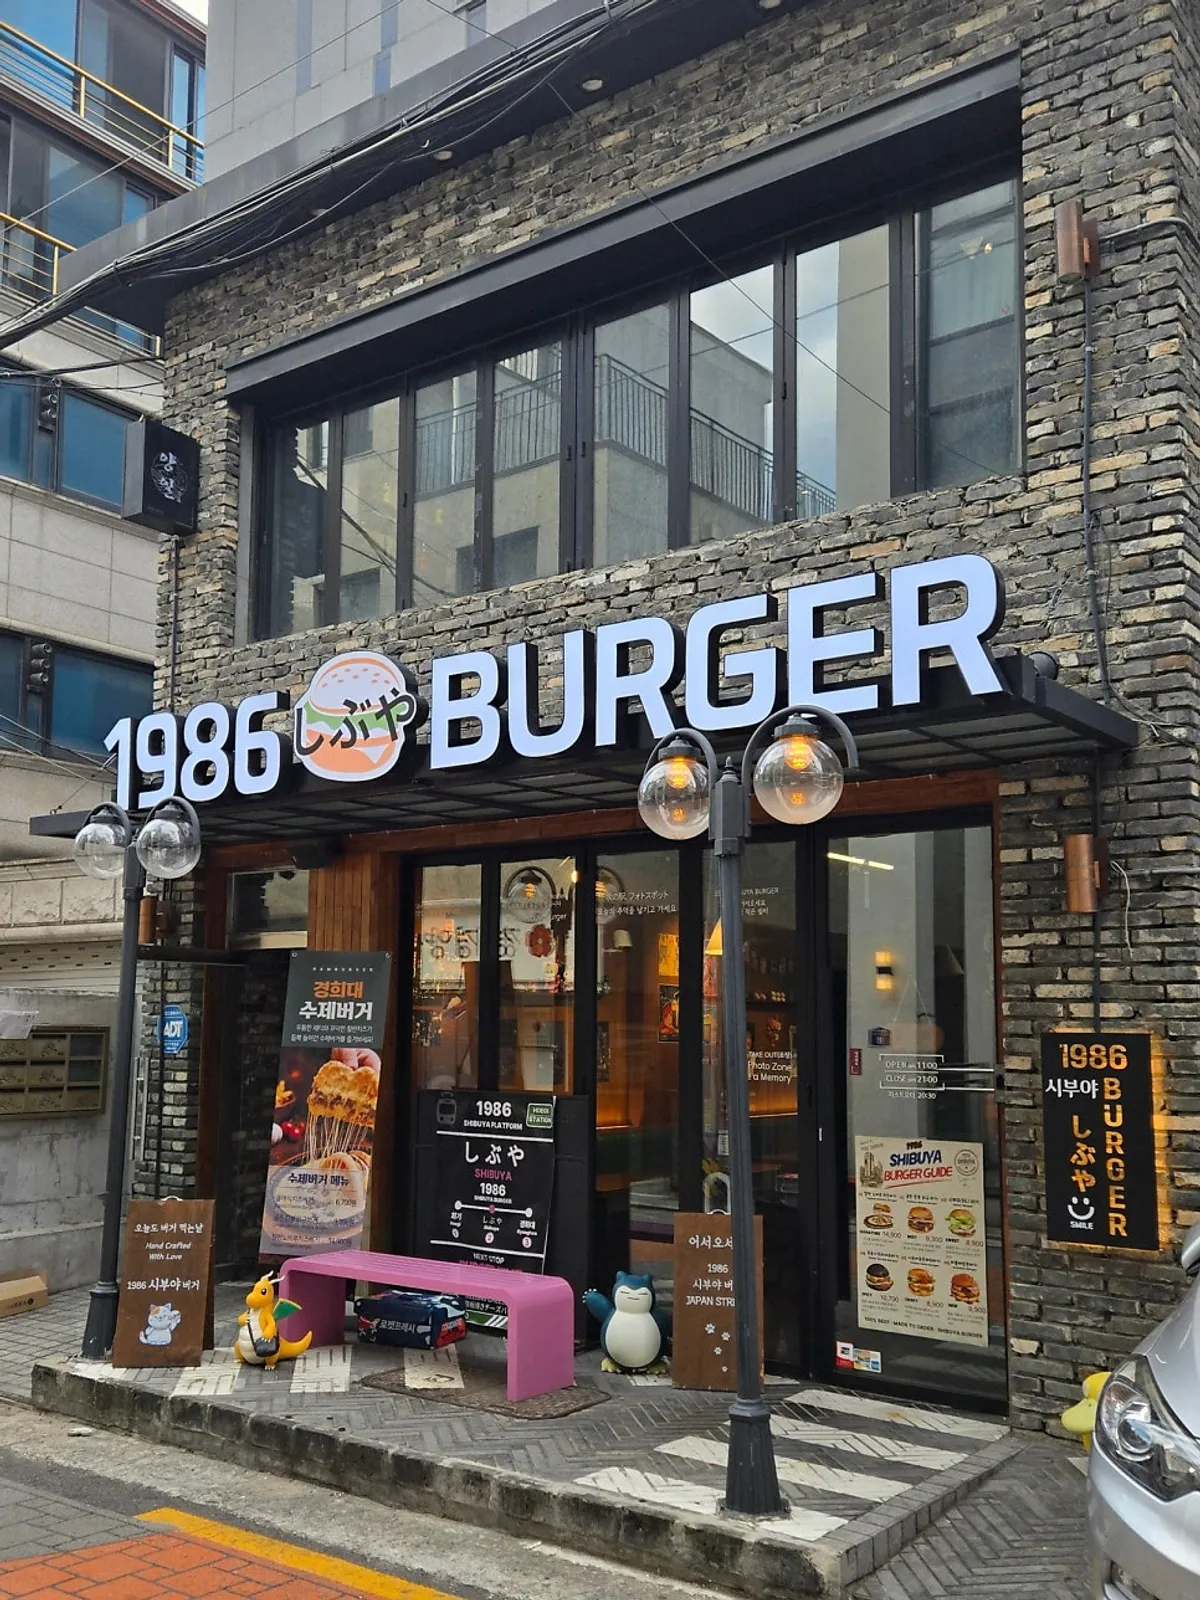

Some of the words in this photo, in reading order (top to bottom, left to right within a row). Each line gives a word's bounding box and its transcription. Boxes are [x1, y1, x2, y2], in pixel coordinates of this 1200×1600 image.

[103, 692, 281, 810] 1986
[297, 687, 415, 755] しぶや
[430, 553, 1003, 769] BURGER
[314, 981, 363, 998] 경희대
[299, 1001, 373, 1020] 수제버거
[163, 1020, 183, 1038] ADT
[1059, 1043, 1128, 1070] 1986
[747, 1061, 770, 1071] Photo
[771, 1062, 792, 1071] Zone
[885, 1061, 907, 1069] OPEN
[917, 1061, 938, 1070] 11:00
[760, 1073, 791, 1084] Memory
[885, 1074, 906, 1082] CLOSE
[917, 1075, 938, 1083] 21:00
[1045, 1078, 1099, 1099] 시부야
[476, 1100, 511, 1117] 1986
[463, 1119, 491, 1128] SHIBUYA
[491, 1121, 523, 1131] PLATFORM
[465, 1141, 525, 1167] しぶや
[889, 1150, 942, 1167] SHIBUYA
[1069, 1115, 1097, 1193] しぶや
[1103, 1077, 1128, 1237] BURGER
[288, 1173, 328, 1184] 수제버거
[330, 1174, 350, 1186] 메뉴
[474, 1168, 512, 1181] SHIBUYA
[884, 1167, 923, 1181] BURGER
[923, 1166, 953, 1179] GUIDE
[480, 1182, 506, 1197] 1986
[134, 1223, 158, 1234] 오늘도
[160, 1223, 177, 1233] 버거
[1069, 1220, 1094, 1230] SMILE
[145, 1242, 164, 1250] Hand
[165, 1241, 192, 1250] Crafted
[488, 1255, 505, 1264] STOP
[707, 1263, 729, 1274] 1986
[127, 1280, 147, 1290] 1986
[148, 1277, 182, 1292] 시부야
[182, 1279, 200, 1291] 버거
[693, 1279, 722, 1292] 시부야
[686, 1296, 714, 1306] JAPAN
[378, 1319, 416, 1333] 로켓프레시
